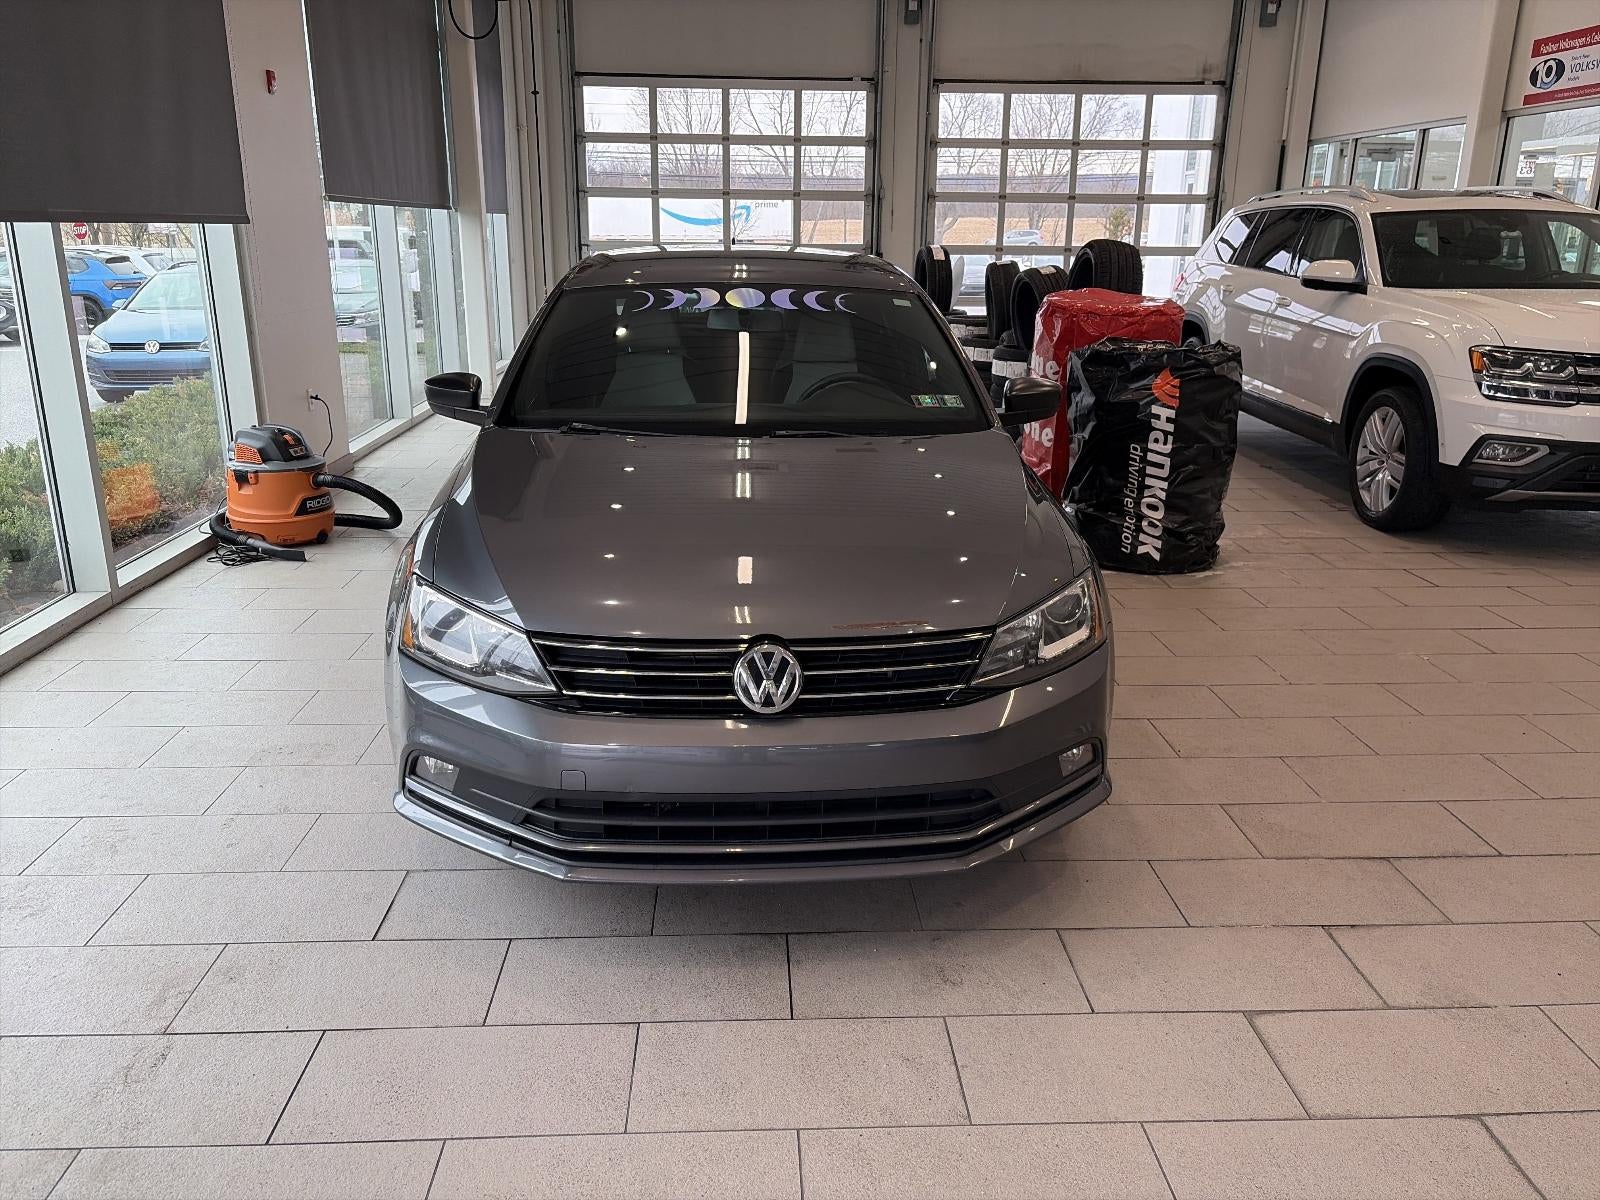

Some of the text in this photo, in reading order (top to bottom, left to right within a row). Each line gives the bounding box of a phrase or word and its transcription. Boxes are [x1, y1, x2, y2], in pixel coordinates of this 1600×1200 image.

[1535, 60, 1557, 88] 10
[754, 201, 779, 209] prime
[73, 226, 87, 235] STOP
[1122, 443, 1141, 497] driving
[734, 644, 802, 714] VW
